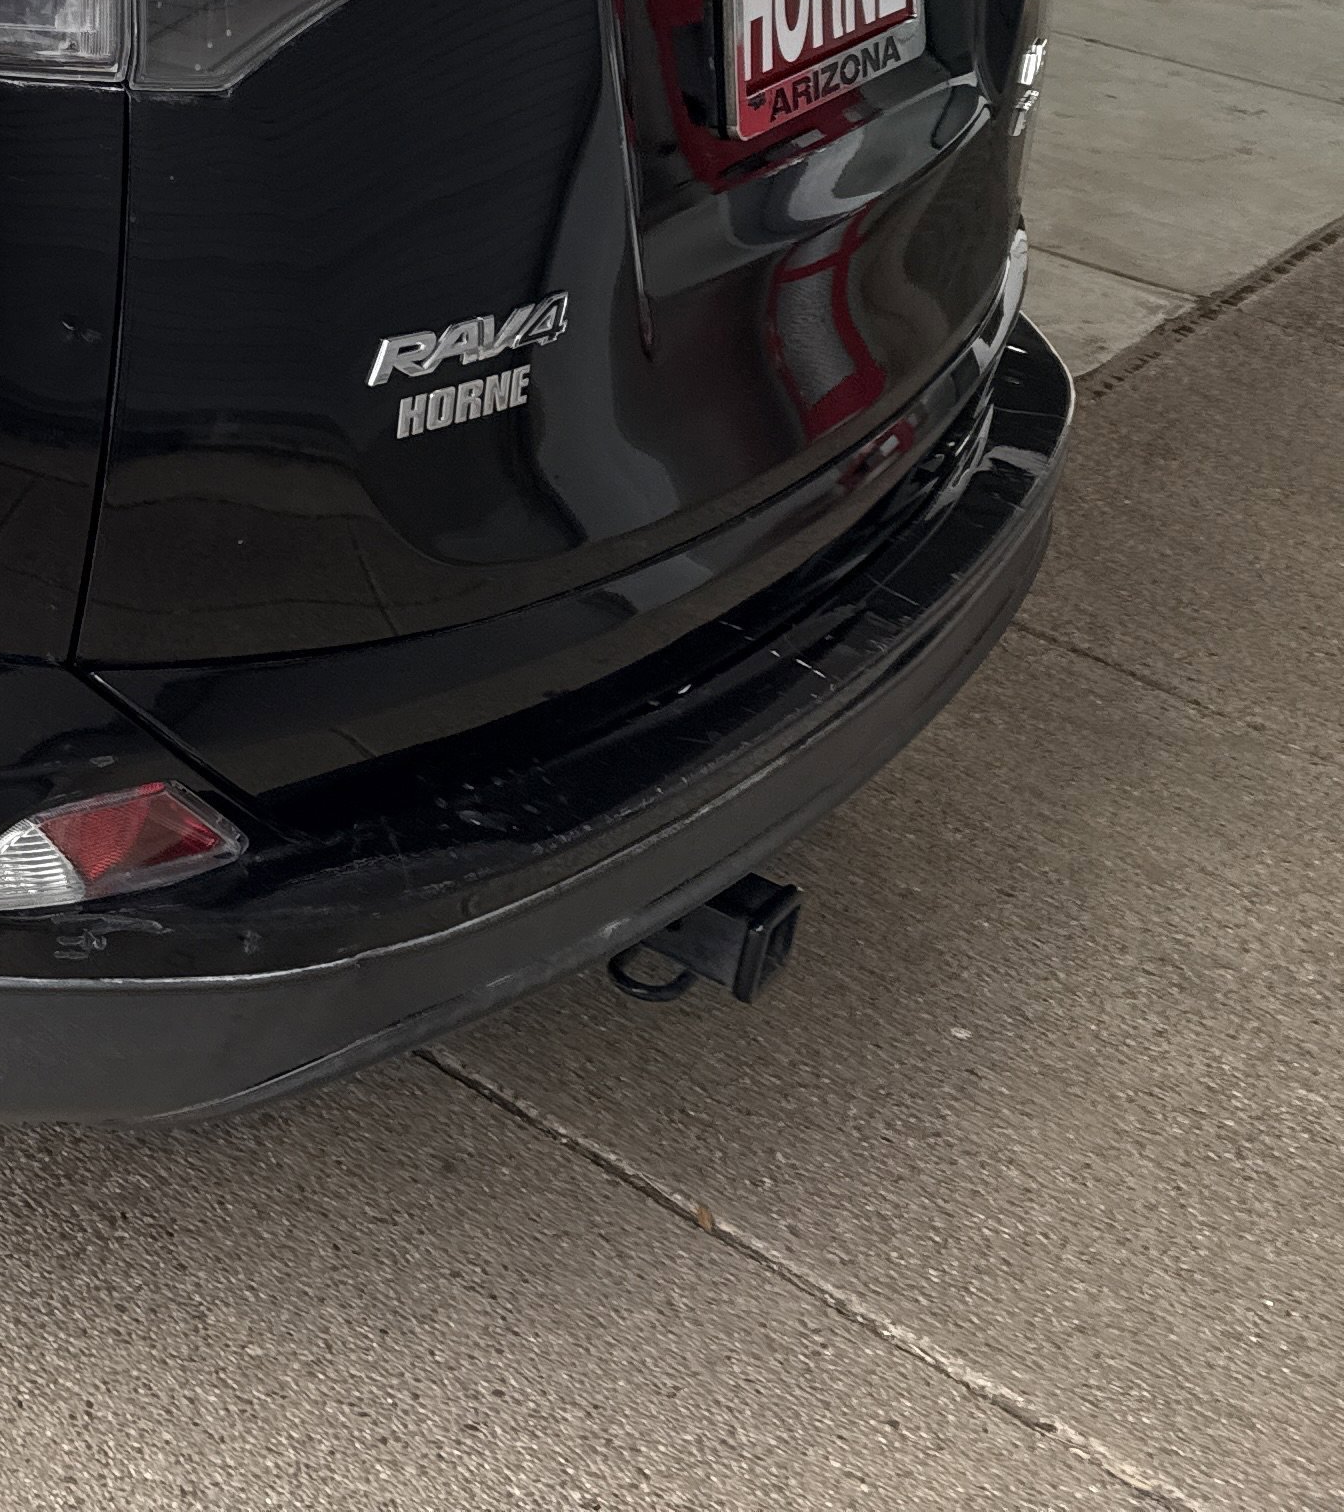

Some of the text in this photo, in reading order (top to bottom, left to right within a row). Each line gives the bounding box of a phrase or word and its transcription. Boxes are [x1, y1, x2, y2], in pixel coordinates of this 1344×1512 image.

[769, 35, 902, 123] ARIZONA
[368, 291, 569, 386] RAV4
[397, 364, 531, 439] HORNE
